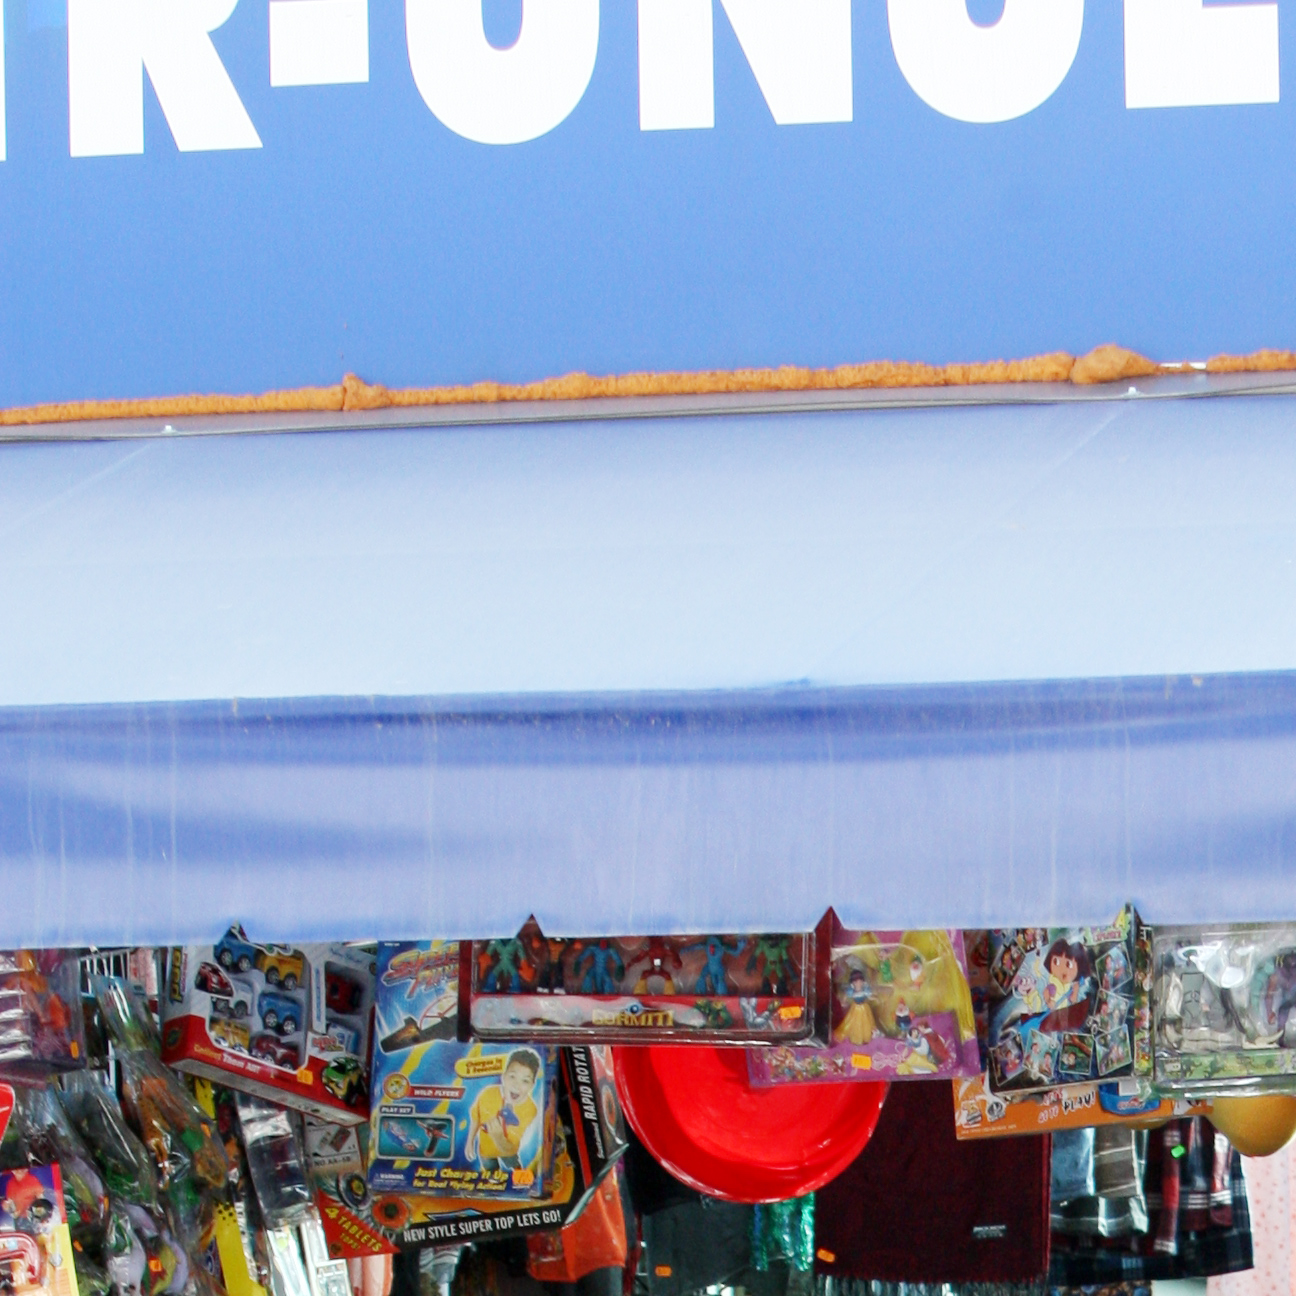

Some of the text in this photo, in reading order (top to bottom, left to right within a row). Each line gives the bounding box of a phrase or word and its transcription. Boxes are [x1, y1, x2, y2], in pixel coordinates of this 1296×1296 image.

[380, 1106, 398, 1114] PLAY
[579, 1086, 598, 1120] RAPID
[415, 1167, 437, 1179] Just
[440, 1168, 479, 1181] Charge
[492, 1171, 509, 1184] Up
[427, 1180, 448, 1189] Real
[338, 1215, 382, 1252] TABLETS
[403, 1209, 562, 1243] NEW STYLE SUPER TOP LETS GO!
